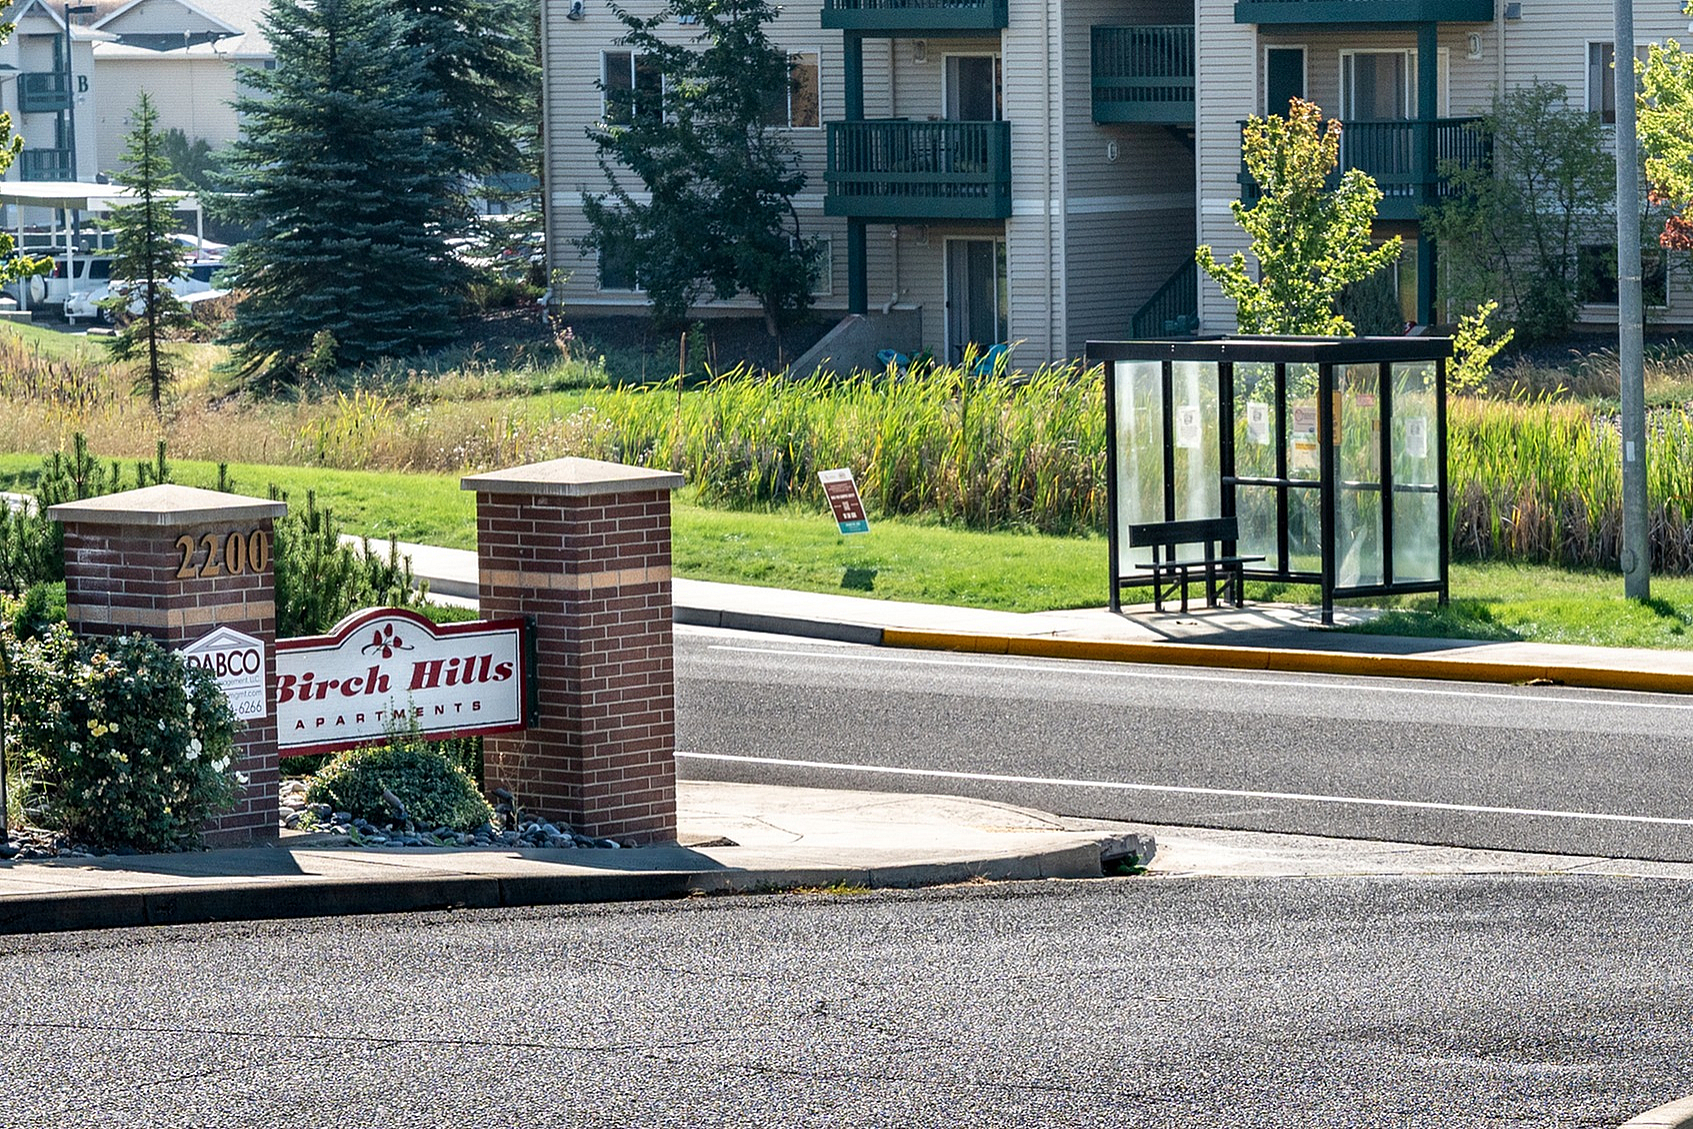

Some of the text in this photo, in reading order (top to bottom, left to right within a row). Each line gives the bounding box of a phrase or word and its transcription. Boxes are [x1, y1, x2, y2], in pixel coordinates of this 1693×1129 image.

[77, 75, 89, 92] B
[176, 529, 269, 578] 2200
[276, 653, 514, 703] Birch Hills
[295, 700, 481, 730] APARTMENTS
